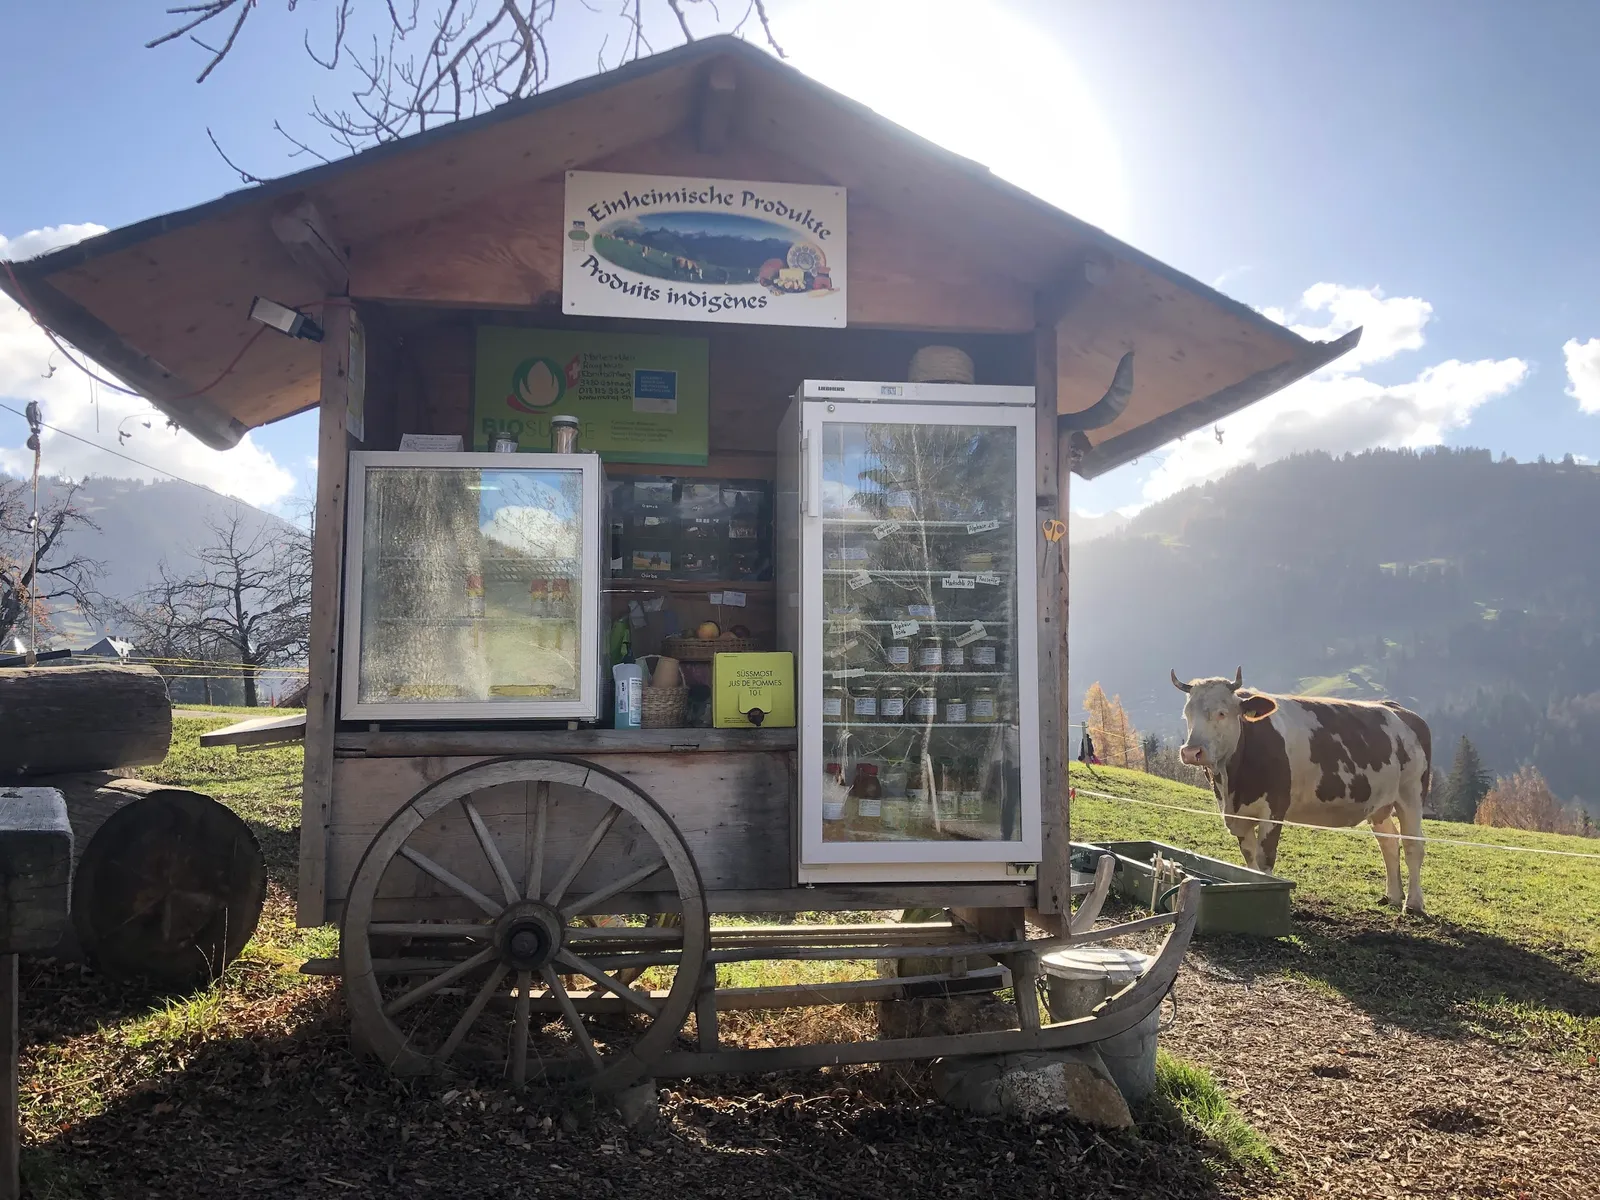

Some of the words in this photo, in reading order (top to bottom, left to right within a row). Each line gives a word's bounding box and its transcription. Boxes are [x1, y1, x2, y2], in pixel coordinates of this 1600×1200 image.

[587, 185, 734, 222] Einheimische
[741, 190, 831, 240] Produkte
[580, 254, 661, 302] Produits
[667, 287, 768, 313] indigènes
